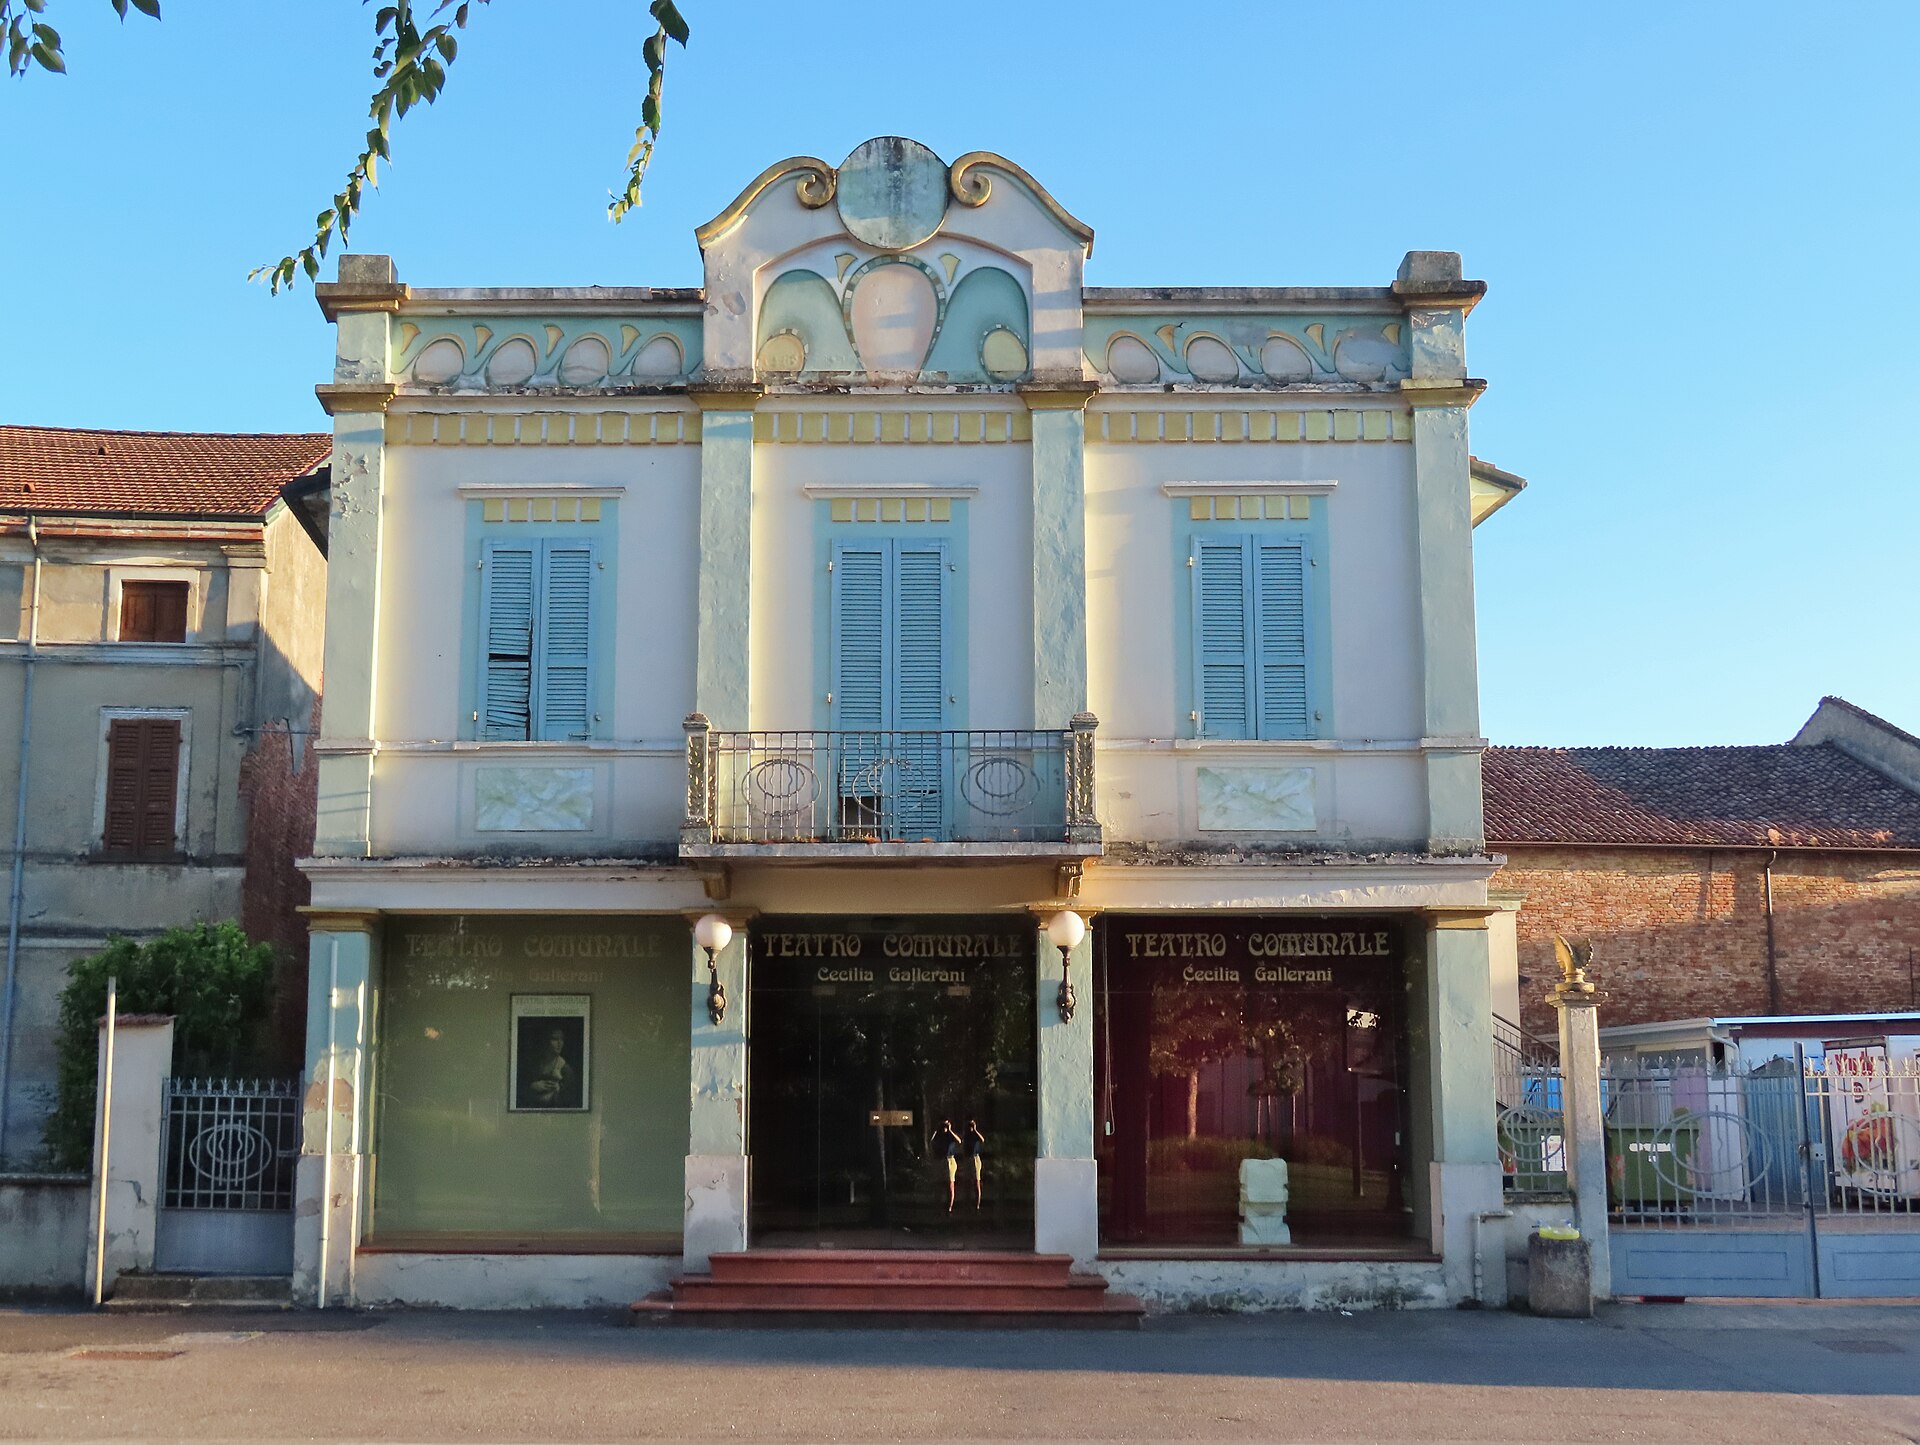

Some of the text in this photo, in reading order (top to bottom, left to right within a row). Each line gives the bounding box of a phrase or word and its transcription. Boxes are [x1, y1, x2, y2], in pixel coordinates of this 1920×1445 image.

[404, 933, 662, 957] TEATRO COMUNALE
[762, 933, 1022, 957] TEATRO COMUNALE
[1125, 932, 1390, 957] TEATRO COMUNALE
[817, 966, 965, 982] Cecilia Gallerani
[1182, 966, 1333, 982] Cecilia Gallerani
